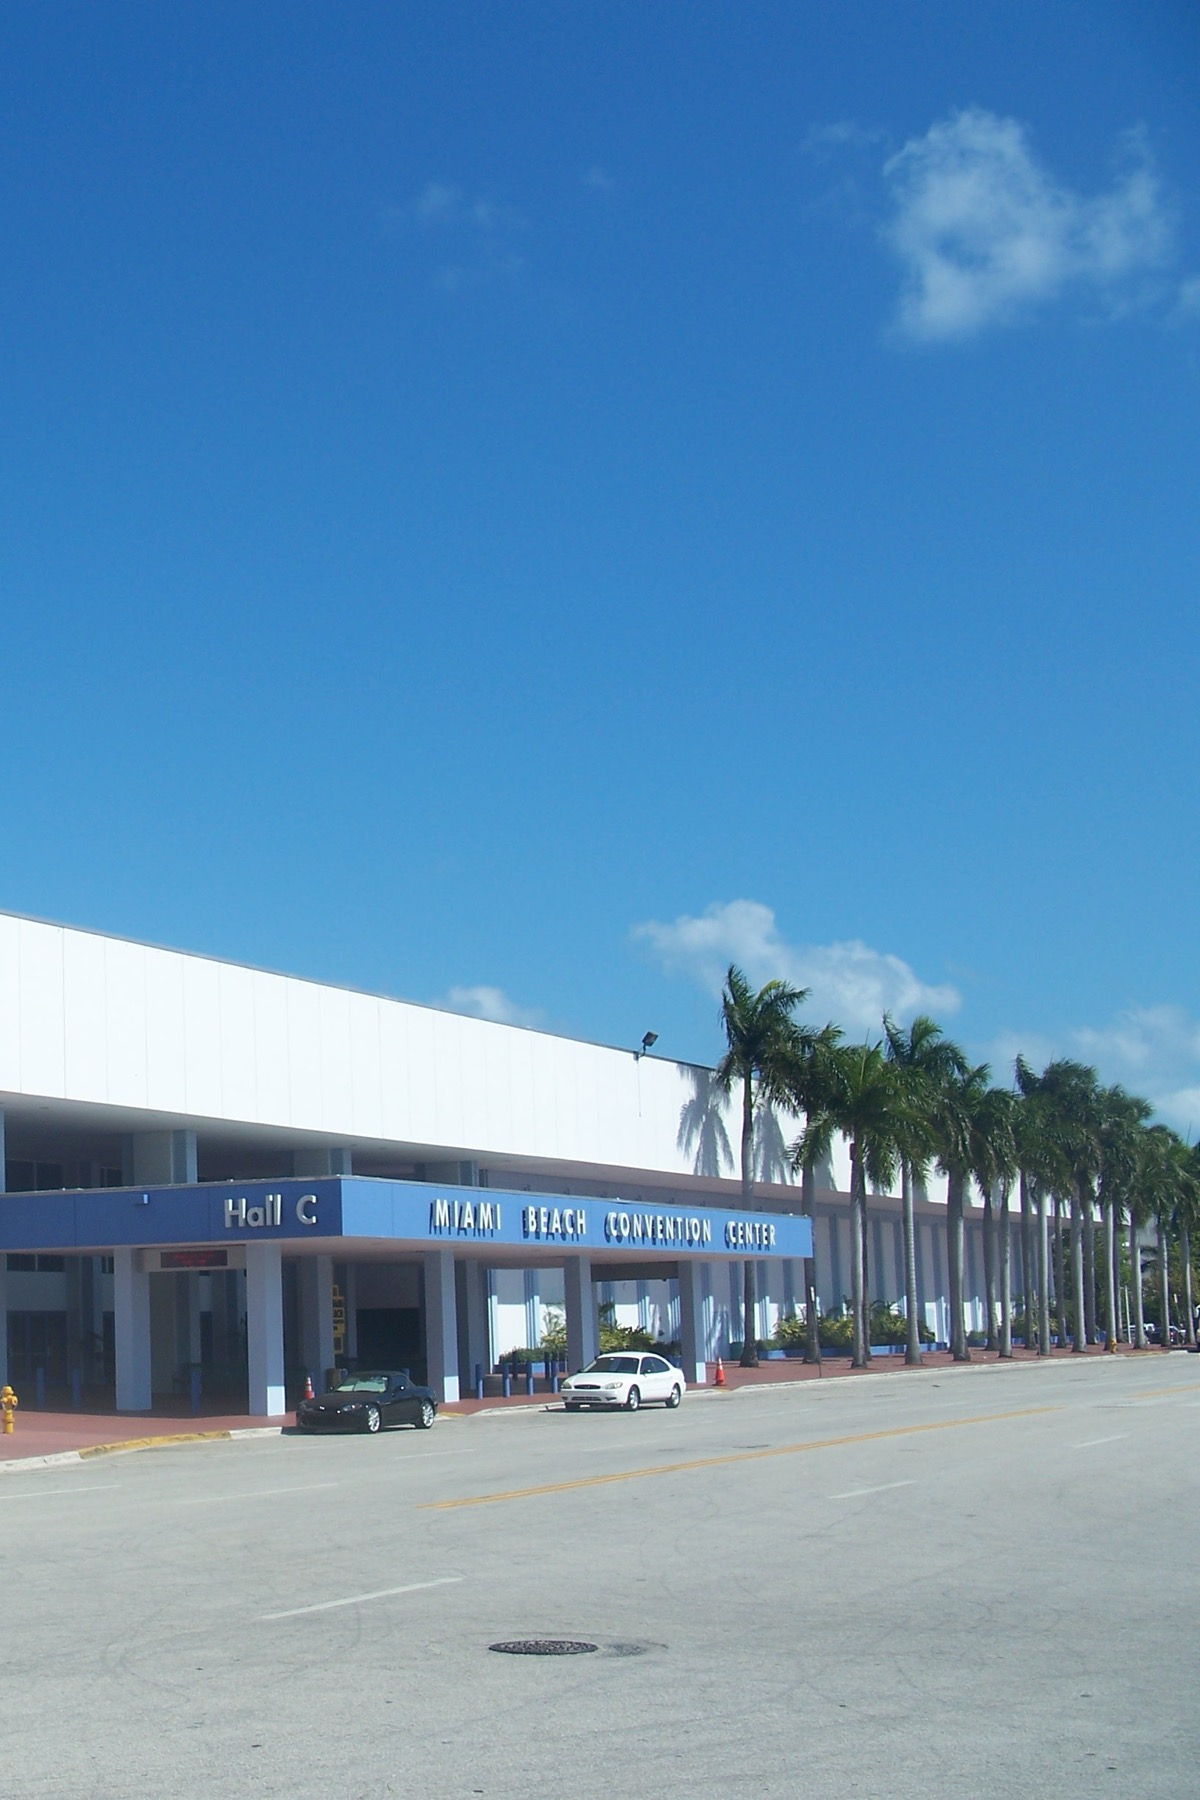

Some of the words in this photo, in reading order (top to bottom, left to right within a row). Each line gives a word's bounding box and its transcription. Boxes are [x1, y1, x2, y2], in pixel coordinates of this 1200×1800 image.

[224, 1194, 281, 1229] Hall
[296, 1194, 317, 1225] C
[434, 1199, 502, 1230] MIAMI
[526, 1206, 586, 1235] BEACH
[606, 1211, 712, 1242] CONVENTION
[727, 1220, 776, 1246] CENTER
